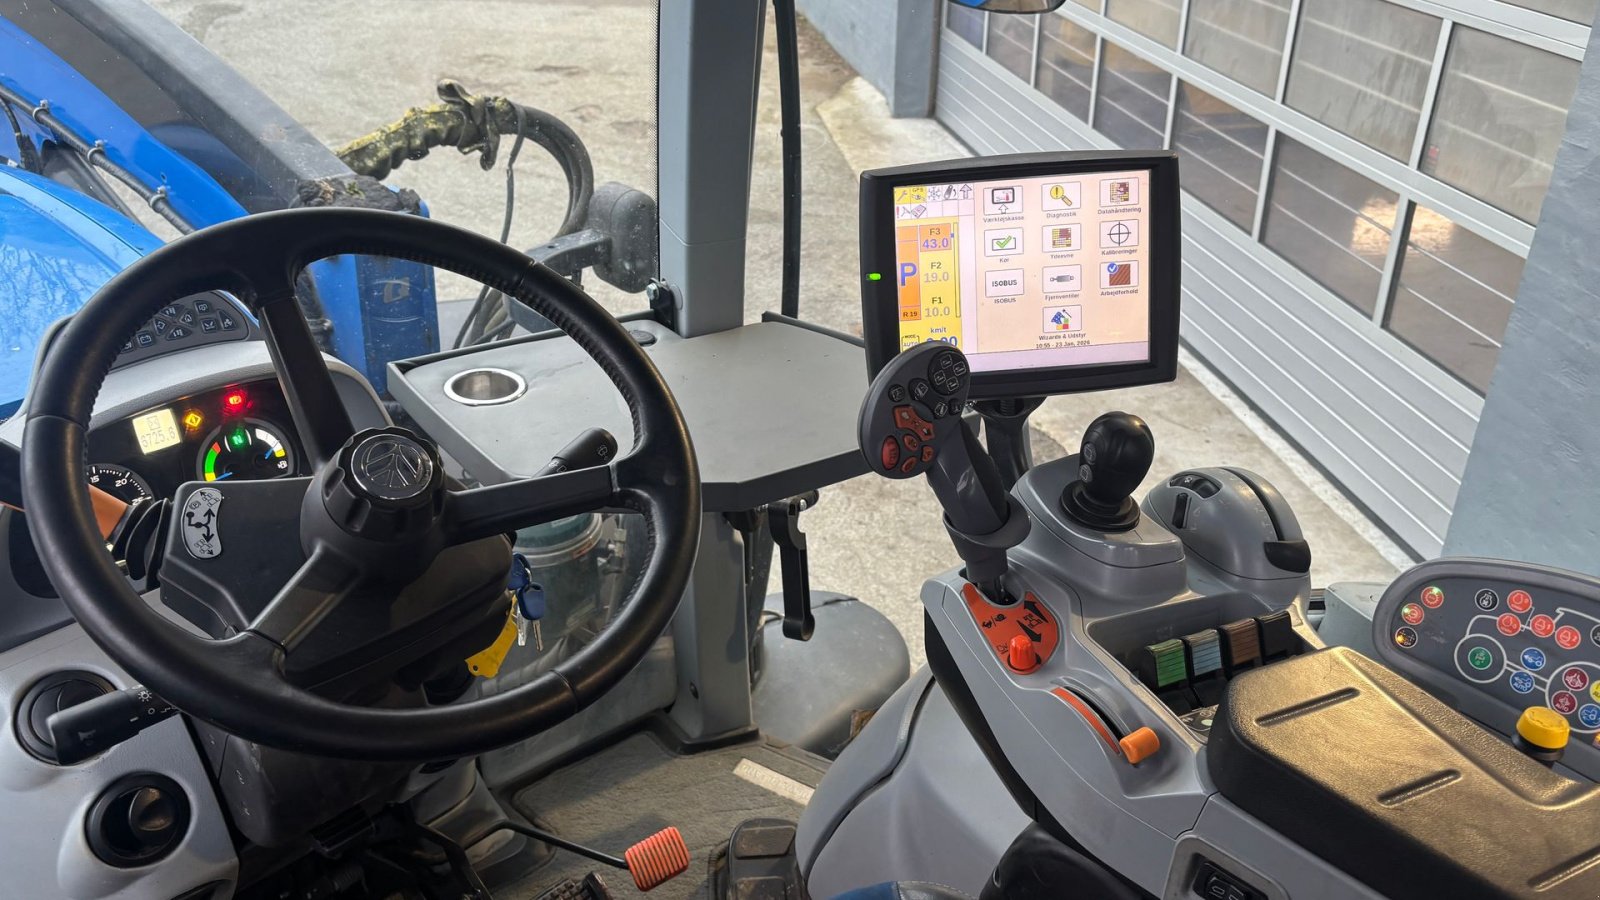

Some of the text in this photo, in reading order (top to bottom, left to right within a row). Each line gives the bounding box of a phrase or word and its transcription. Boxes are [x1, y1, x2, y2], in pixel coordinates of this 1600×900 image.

[1097, 206, 1141, 215] Datahåndtering
[983, 215, 1025, 223] Værktøjskasse
[929, 228, 941, 236] F3
[922, 237, 949, 249] 43.0
[1101, 248, 1138, 256] Kalibreringer
[930, 261, 942, 269] F2
[900, 262, 918, 287] P
[924, 271, 950, 283] 19.0
[991, 279, 1018, 287] ISOBUS
[931, 296, 943, 304] F1
[1044, 293, 1080, 301] Fjernventiler
[925, 306, 950, 318] 10.0
[1067, 332, 1087, 340] Udstyr
[140, 426, 176, 449] 6725.6
[232, 434, 243, 445] N
[90, 475, 100, 484] 15
[114, 478, 128, 488] 20
[1513, 683, 1528, 692] AUTO
[1555, 703, 1570, 712] AUTO
